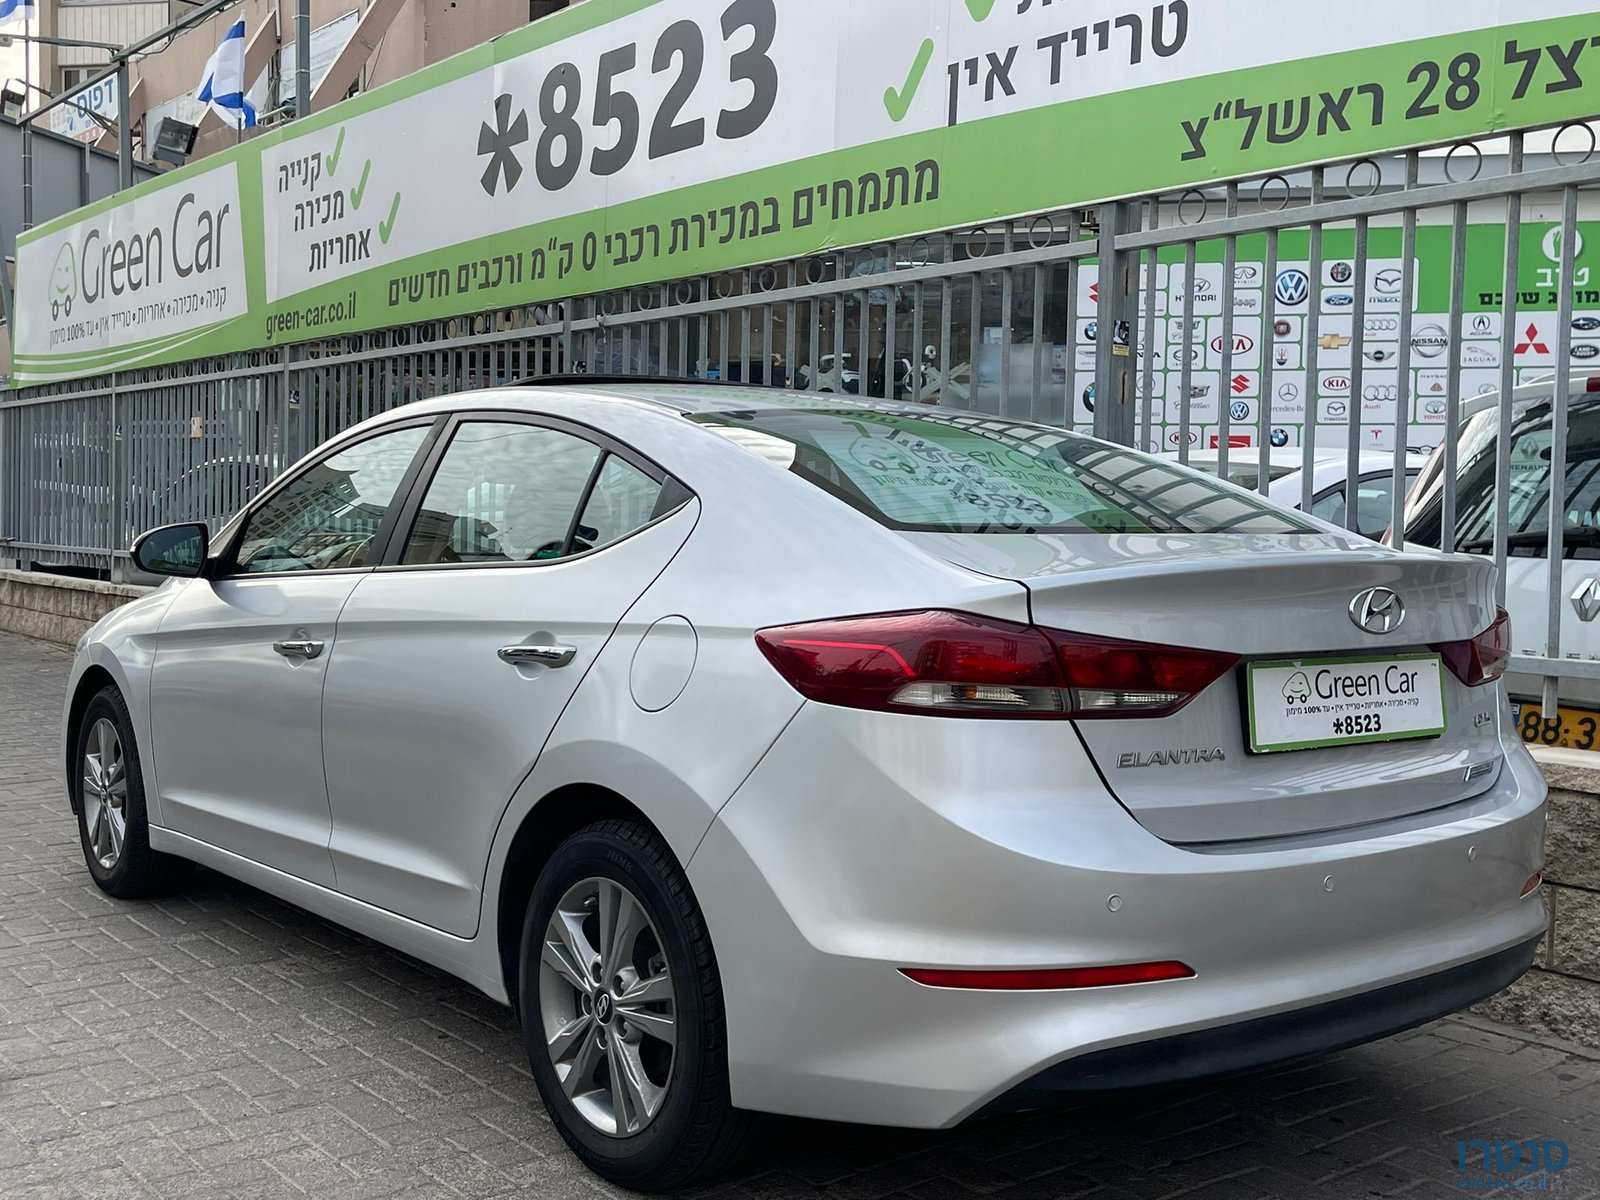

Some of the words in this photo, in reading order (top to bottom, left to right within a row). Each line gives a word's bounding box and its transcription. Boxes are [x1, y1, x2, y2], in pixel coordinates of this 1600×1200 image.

[1037, 0, 1188, 86] טרייד
[947, 45, 1019, 127] אין
[1405, 52, 1480, 120] 28
[279, 151, 321, 193] קנייה
[793, 158, 940, 228] מתמחים
[294, 190, 344, 232] מכירה
[668, 196, 781, 255] במכירת
[81, 227, 162, 304] Green
[172, 193, 230, 278] Car
[309, 228, 371, 272] אחריות
[582, 231, 597, 272] 0
[605, 224, 660, 267] רכבי
[388, 268, 449, 307] חדשים
[456, 252, 523, 294] ורכבים
[137, 301, 167, 325] אחריות
[173, 293, 199, 317] מכירה
[265, 291, 357, 341] green-car.co.il
[67, 320, 85, 342] 100%
[1411, 337, 1448, 345] NISSAN
[1327, 379, 1348, 388] KIA
[1315, 668, 1381, 701] Green
[1384, 664, 1418, 695] Car
[1285, 706, 1303, 718] מימון
[1304, 705, 1321, 715] 100%
[1116, 747, 1226, 769] ELANTRA
